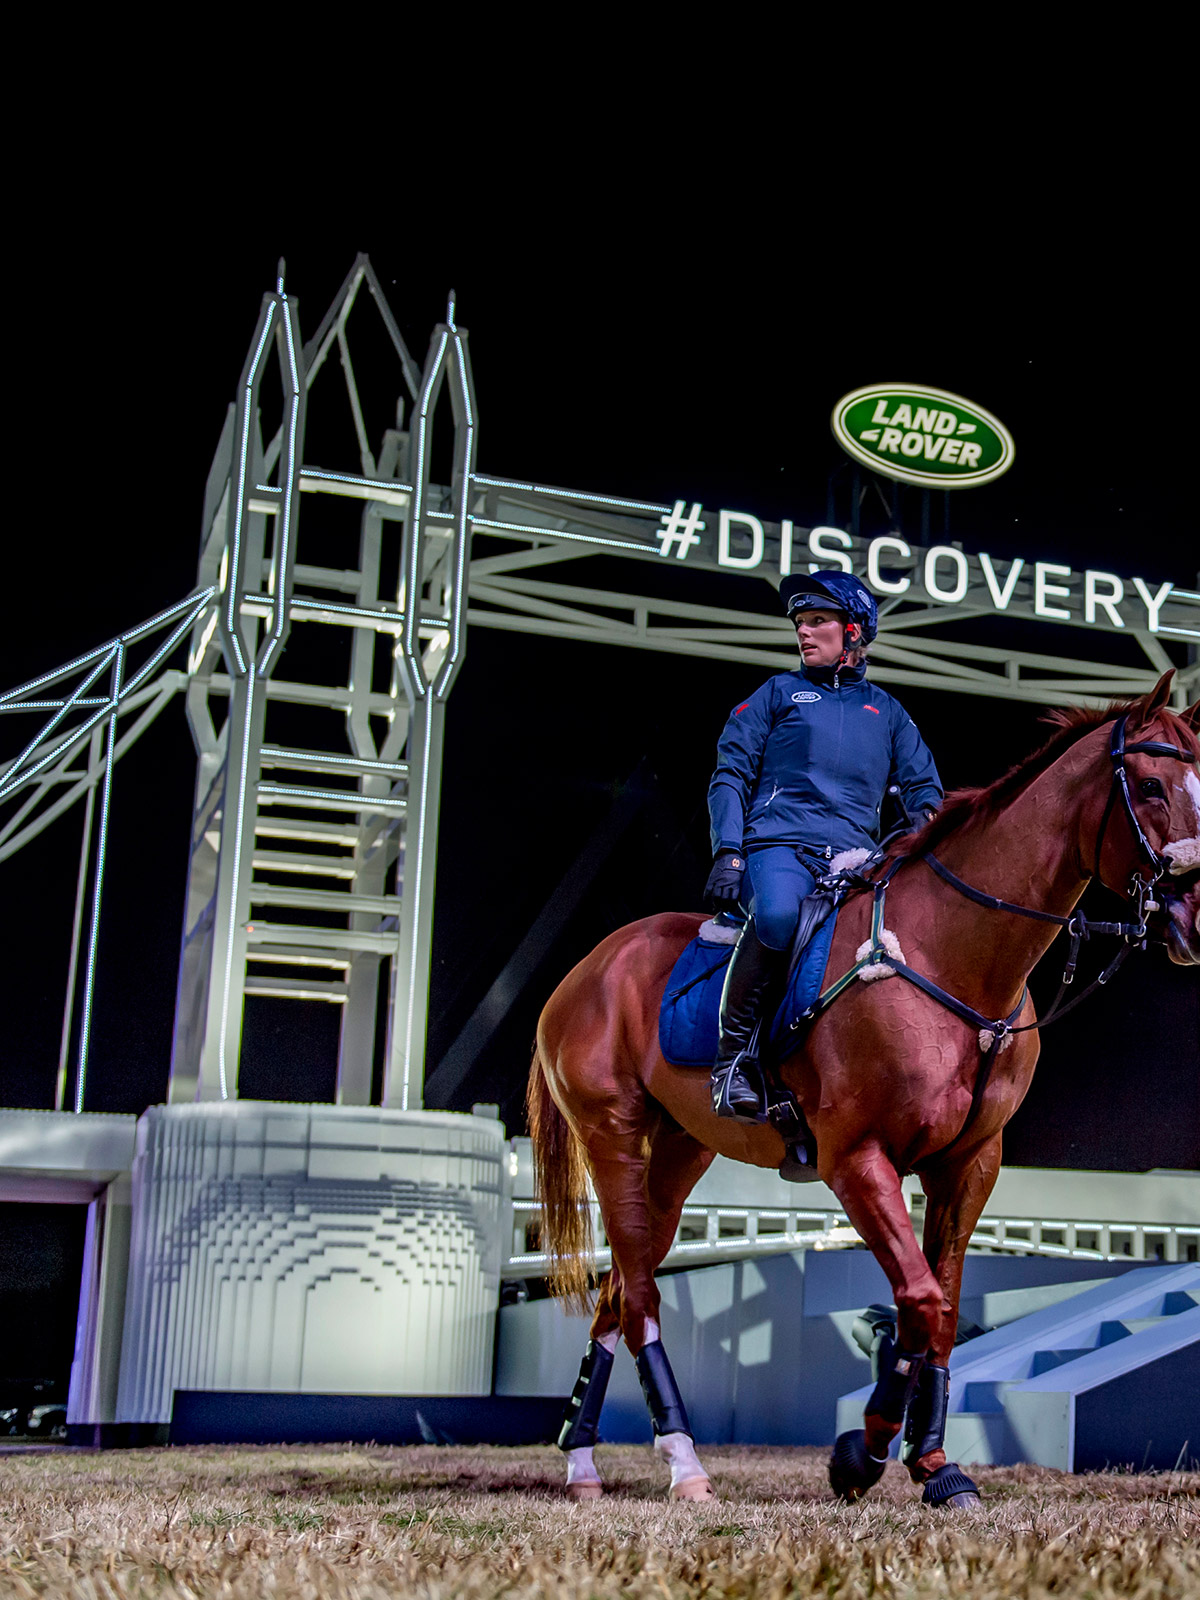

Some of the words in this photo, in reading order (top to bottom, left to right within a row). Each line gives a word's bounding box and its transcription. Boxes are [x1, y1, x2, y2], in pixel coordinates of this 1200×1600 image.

[871, 400, 957, 436] LAND
[878, 428, 982, 468] ROVER
[656, 500, 1175, 633] #DISCOVERY
